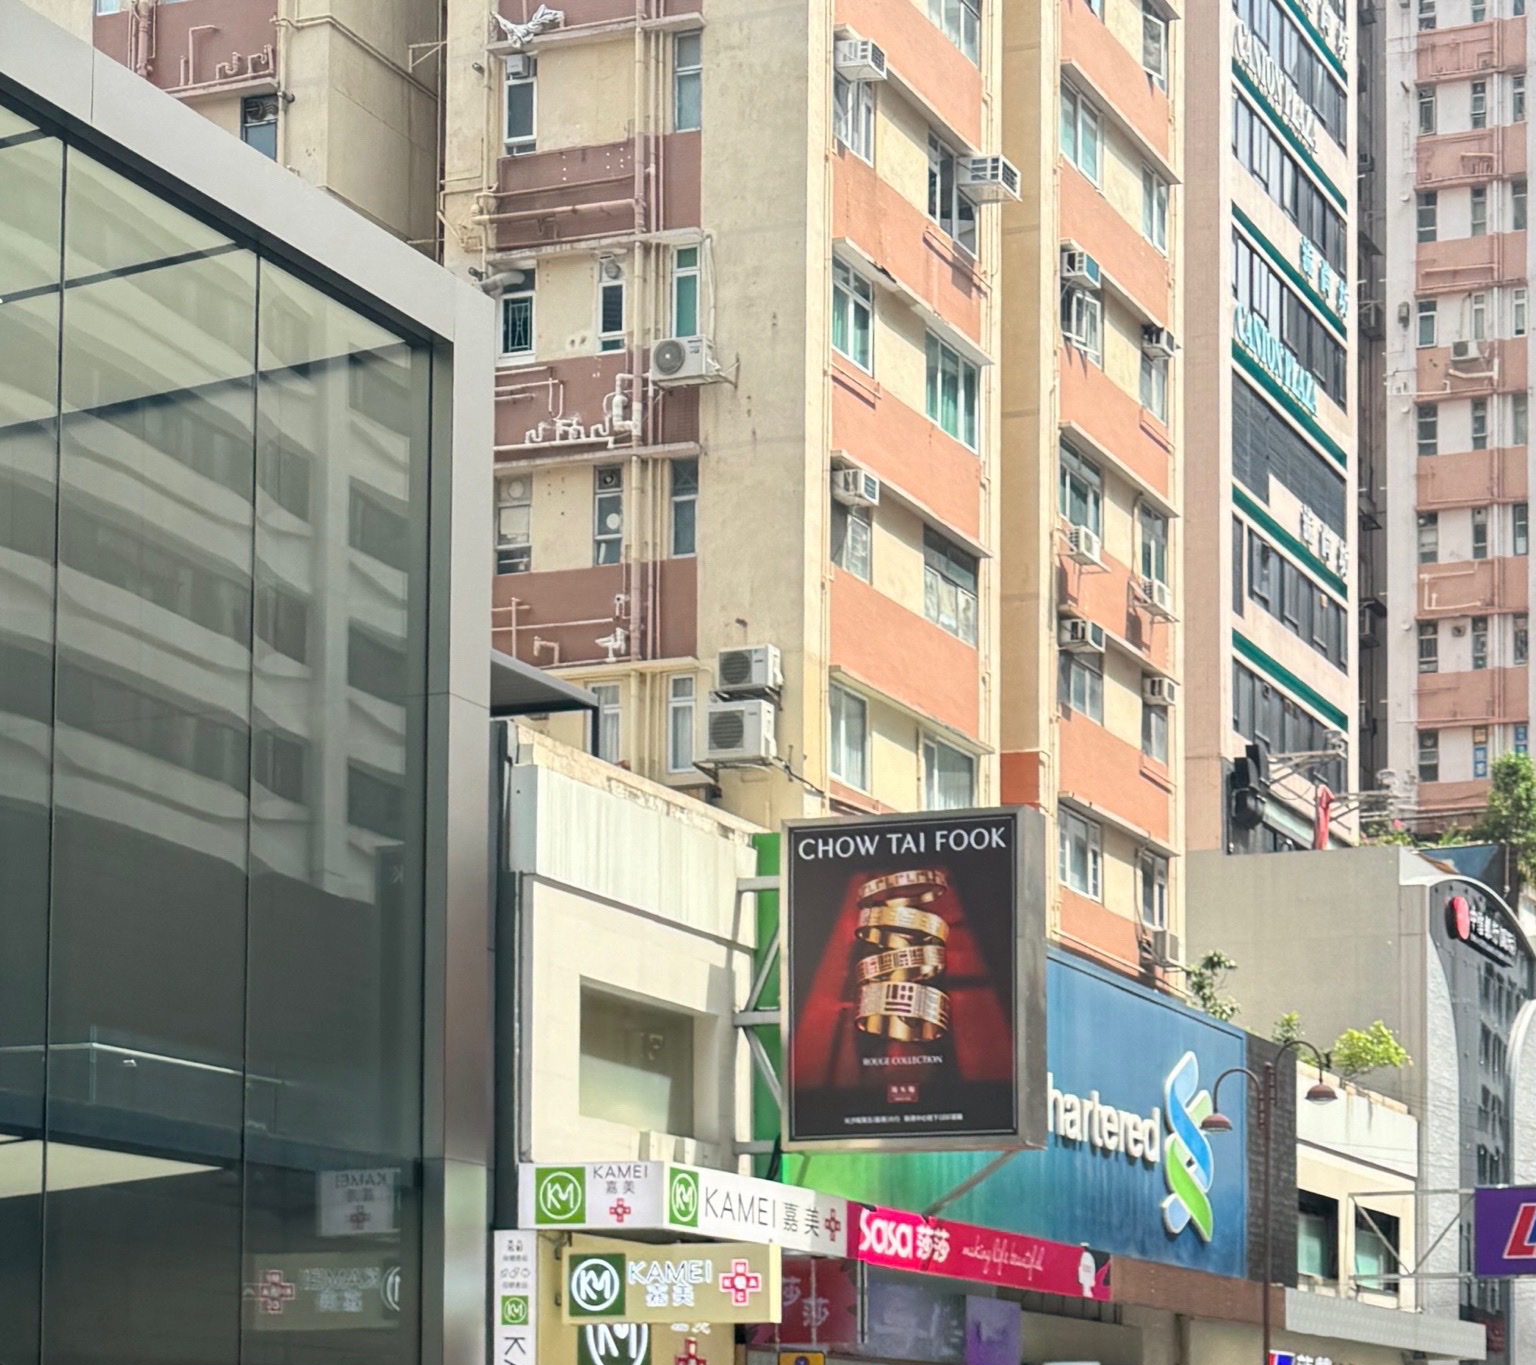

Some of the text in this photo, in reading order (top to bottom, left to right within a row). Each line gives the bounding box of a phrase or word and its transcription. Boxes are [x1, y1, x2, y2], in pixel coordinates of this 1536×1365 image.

[1234, 302, 1318, 417] CANTON PLAZA
[798, 826, 1007, 860] CHOW TAI FOOK
[891, 1054, 943, 1065] COLLECTION
[1047, 1072, 1160, 1163] hartered
[593, 1164, 648, 1180] KAMEI
[606, 1180, 635, 1195] 嘉美
[705, 1186, 820, 1238] KAMEI 嘉美
[917, 1223, 950, 1263] 莎莎
[627, 1259, 713, 1285] KAMEI
